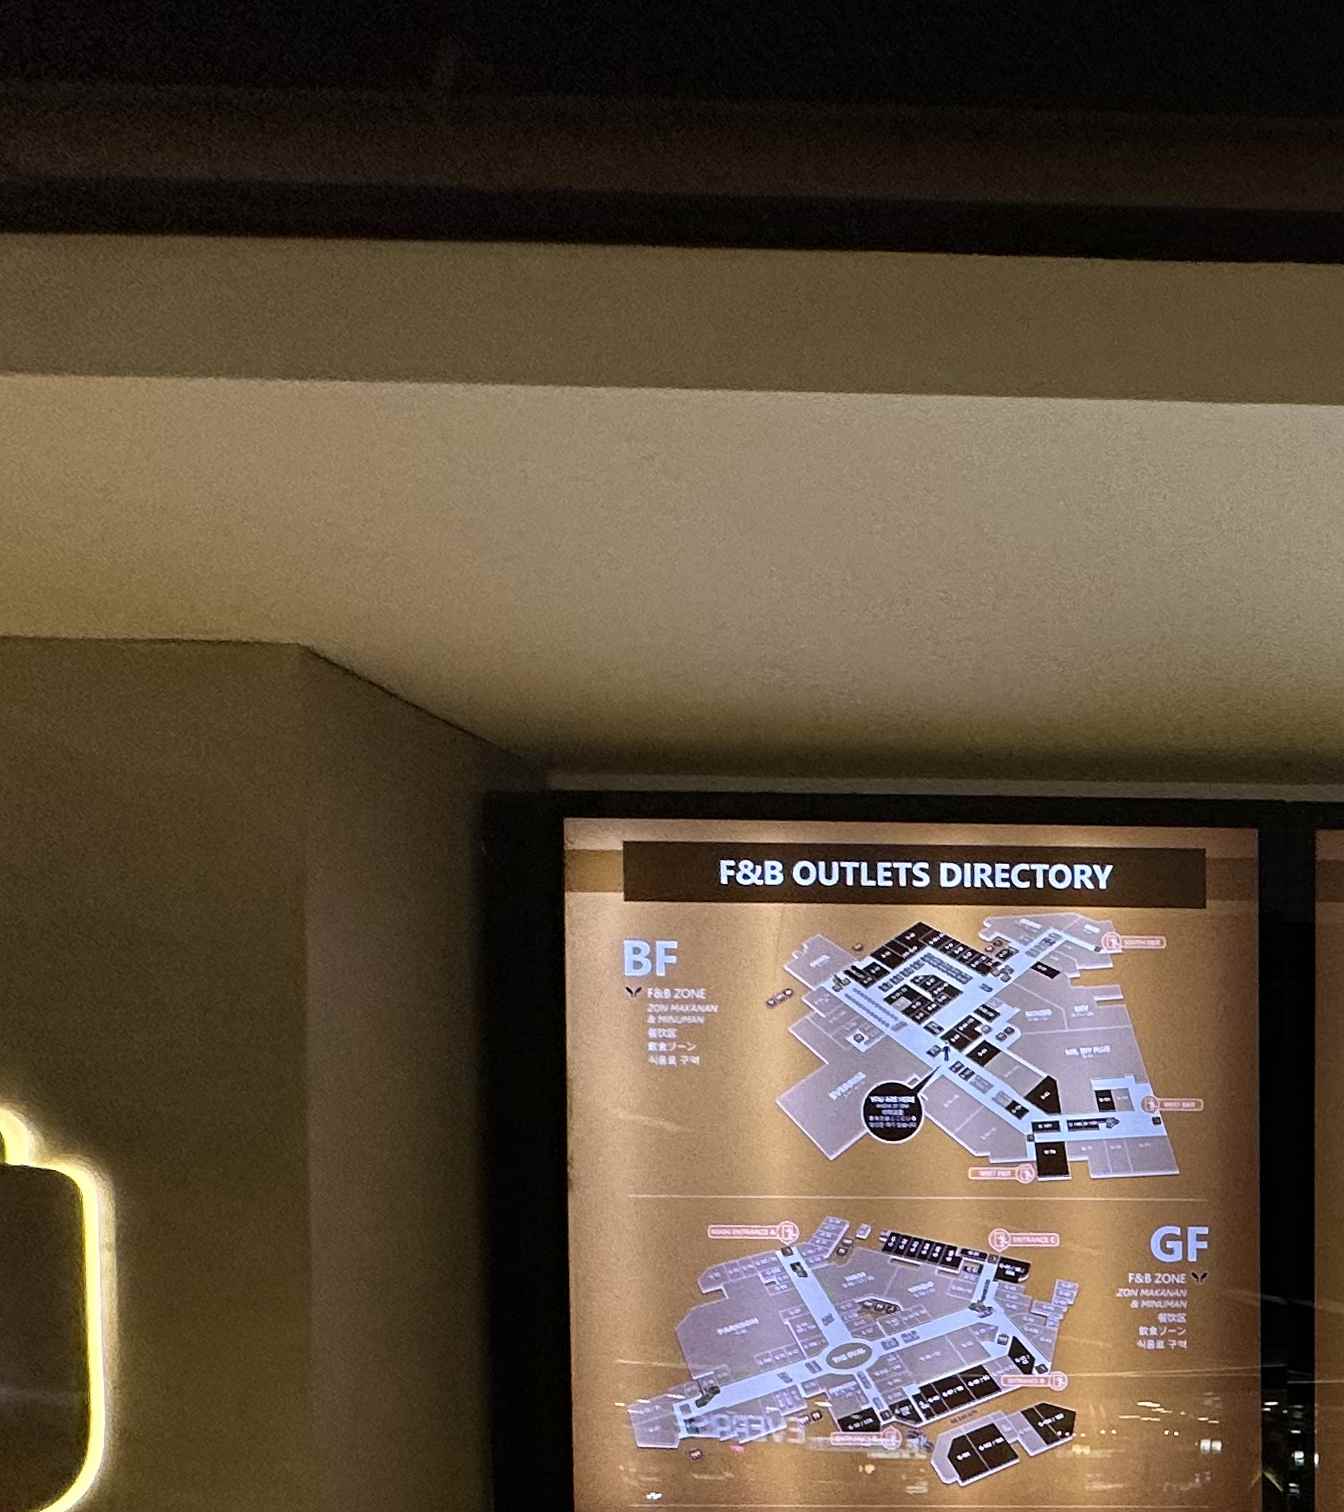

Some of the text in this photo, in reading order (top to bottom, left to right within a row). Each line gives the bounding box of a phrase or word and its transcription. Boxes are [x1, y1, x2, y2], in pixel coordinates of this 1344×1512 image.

[720, 860, 1113, 889] F&B OUTLETS DIRECTORY
[623, 940, 677, 976] BF
[647, 987, 706, 999] F&B ZONE
[647, 1014, 704, 1024] & MINUMAN
[1151, 1226, 1208, 1262] GF
[1128, 1273, 1185, 1283] F&B ZONE
